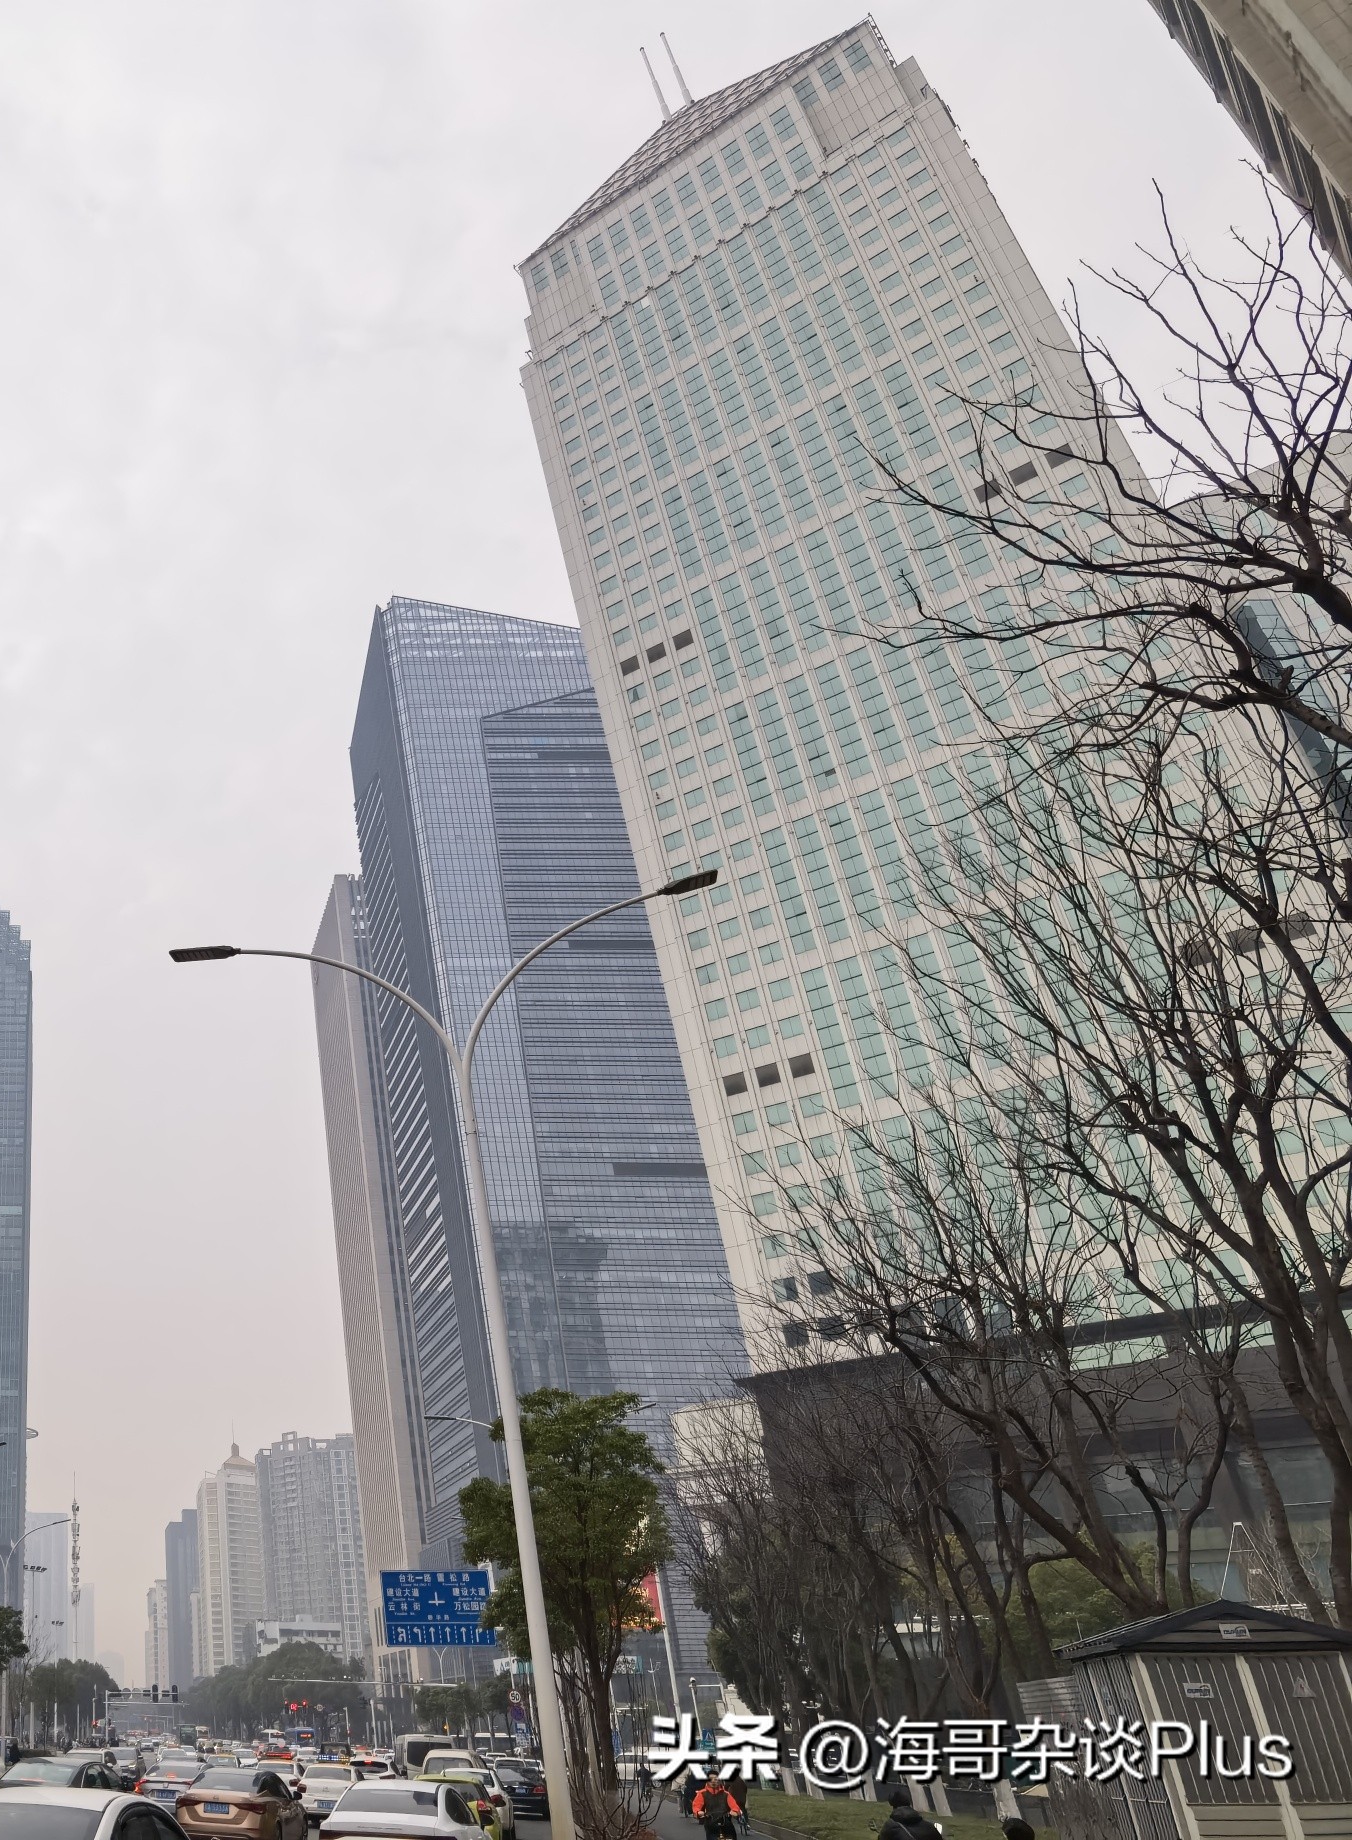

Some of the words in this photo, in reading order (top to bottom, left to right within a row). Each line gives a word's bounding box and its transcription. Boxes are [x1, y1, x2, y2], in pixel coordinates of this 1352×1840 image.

[399, 1573, 431, 1583] 台北一路
[386, 1587, 419, 1597] 建设大道
[452, 1587, 486, 1596] 建设大道
[388, 1602, 421, 1611] 云林街
